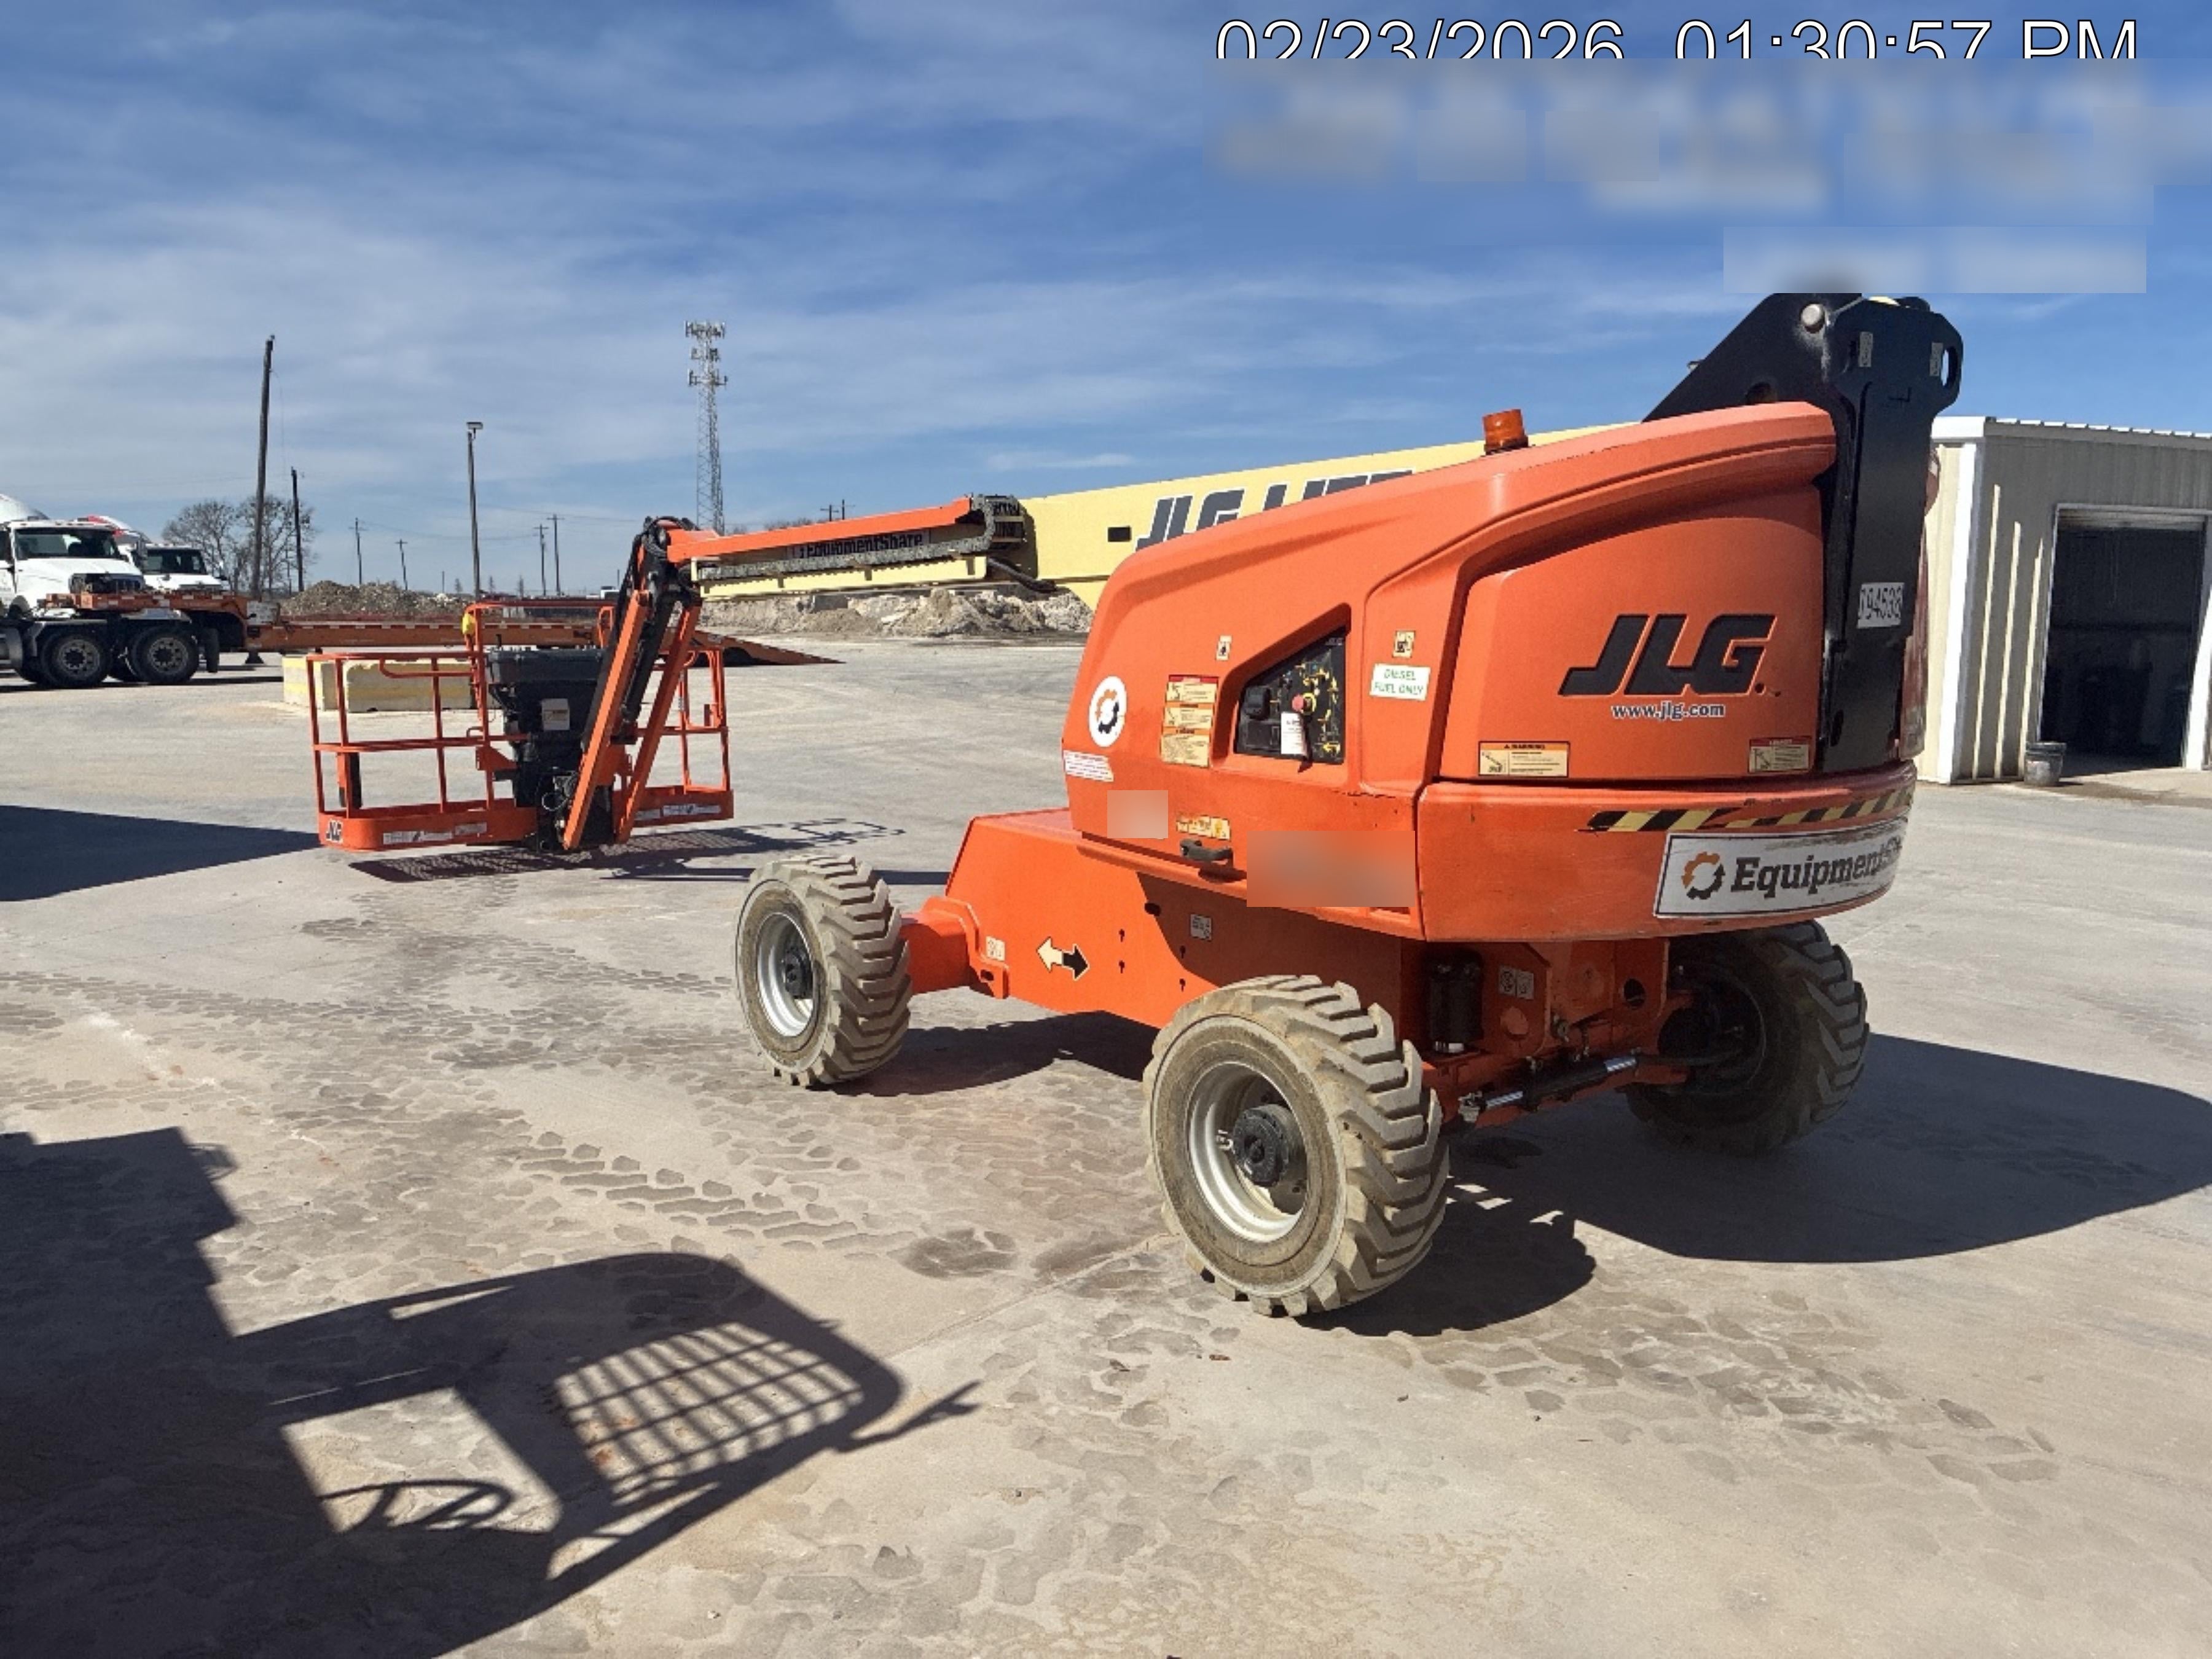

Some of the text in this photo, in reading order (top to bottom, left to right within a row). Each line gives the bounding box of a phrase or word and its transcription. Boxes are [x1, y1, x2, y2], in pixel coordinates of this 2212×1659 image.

[1558, 613, 1778, 696] JLG
[1384, 669, 1416, 681] DIESEL
[1375, 681, 1424, 696] FUEL ONLY
[1611, 701, 1725, 721] www.jlg.com
